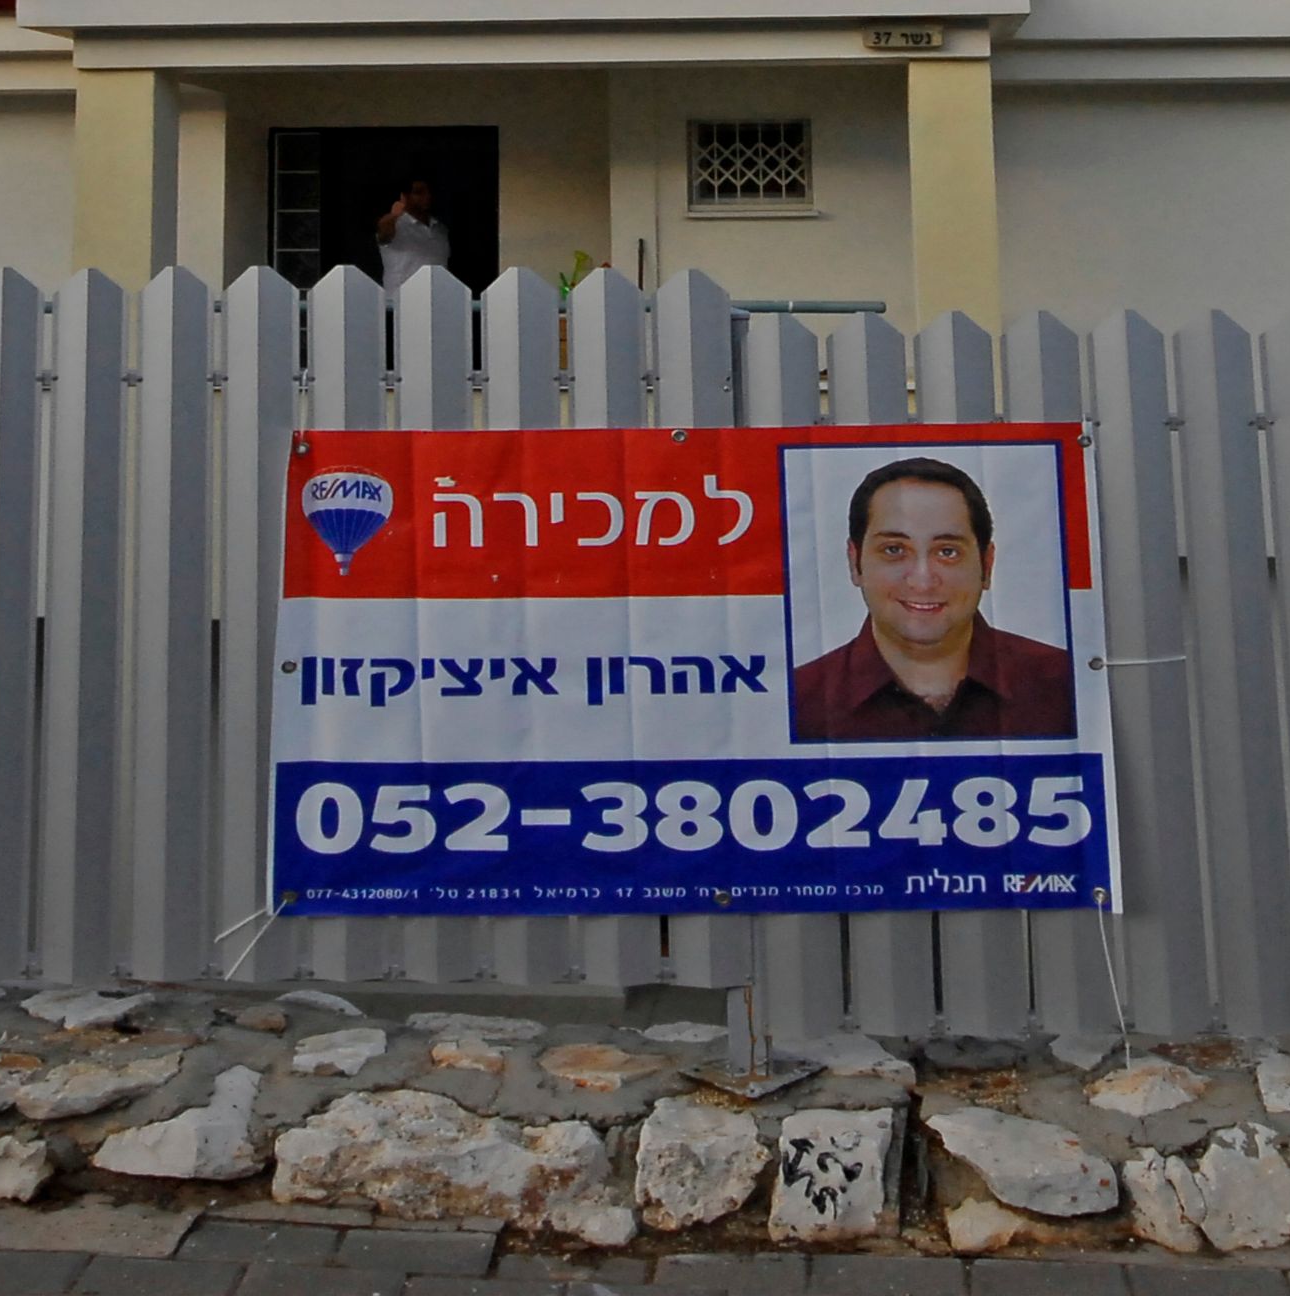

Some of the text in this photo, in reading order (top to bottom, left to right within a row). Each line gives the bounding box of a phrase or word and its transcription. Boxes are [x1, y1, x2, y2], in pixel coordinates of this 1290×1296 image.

[872, 31, 932, 45] נשר 37
[432, 474, 754, 548] למכירה
[301, 654, 770, 708] אהרון איציקזון
[295, 774, 1092, 855] 052-3802485
[905, 868, 987, 894] תגלית
[306, 888, 418, 900] 077-4312080/1
[466, 888, 520, 899] 21831
[533, 886, 601, 898] כרמיאל
[616, 887, 634, 898] 17
[642, 887, 686, 898] משגב
[731, 886, 779, 897] מגדים
[786, 884, 837, 896] מסחרי
[845, 884, 884, 895] מרכז
